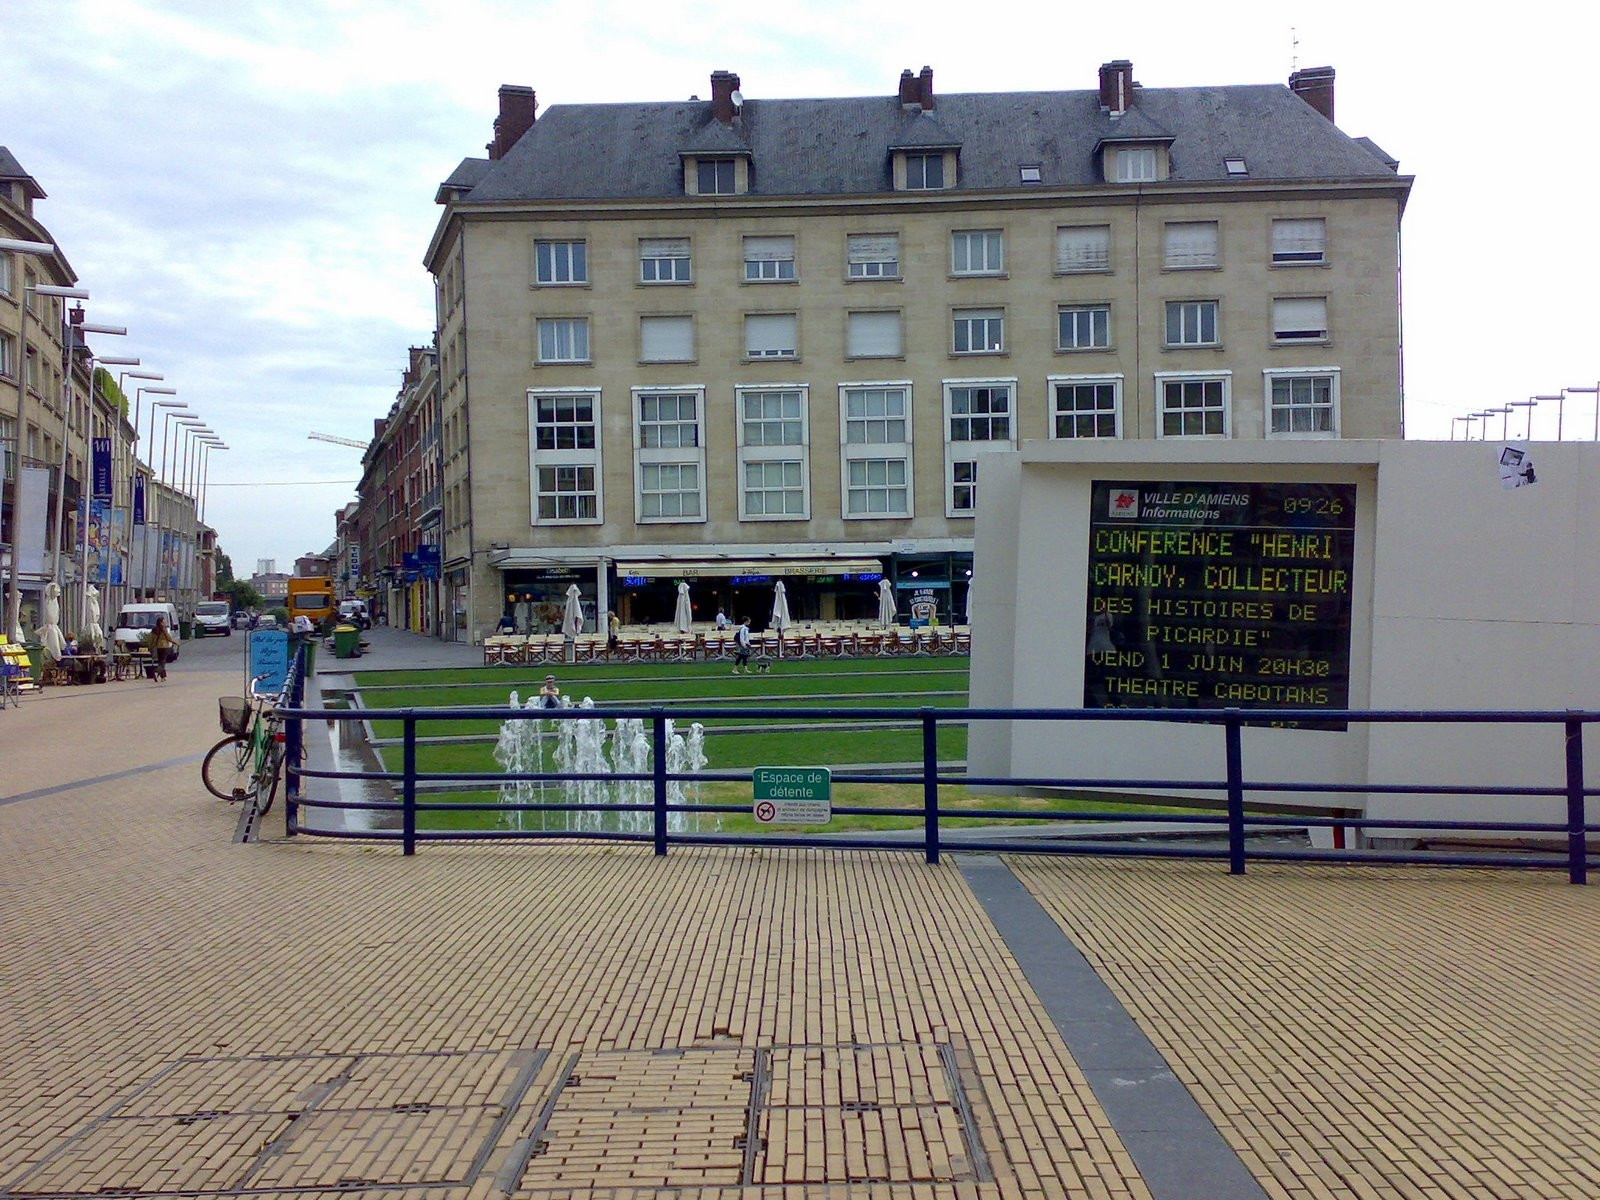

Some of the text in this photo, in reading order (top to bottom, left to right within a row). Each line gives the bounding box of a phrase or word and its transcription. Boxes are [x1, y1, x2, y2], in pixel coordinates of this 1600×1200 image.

[1144, 492, 1250, 506] VILLE D'AMIENS
[1141, 506, 1221, 519] Informations
[1096, 530, 1332, 558] CONFERENCE "HENRI
[1095, 563, 1347, 593] CARNOY, COLLECTEUR
[1093, 597, 1317, 621] DES HISTOIRES DE
[1147, 626, 1270, 646] PICARDIE"
[1091, 650, 1329, 677] VEND 1 JUIN 20H30
[1105, 677, 1329, 704] THEATRE CABOTANS
[760, 771, 822, 785] Espace de
[769, 786, 813, 798] détente
